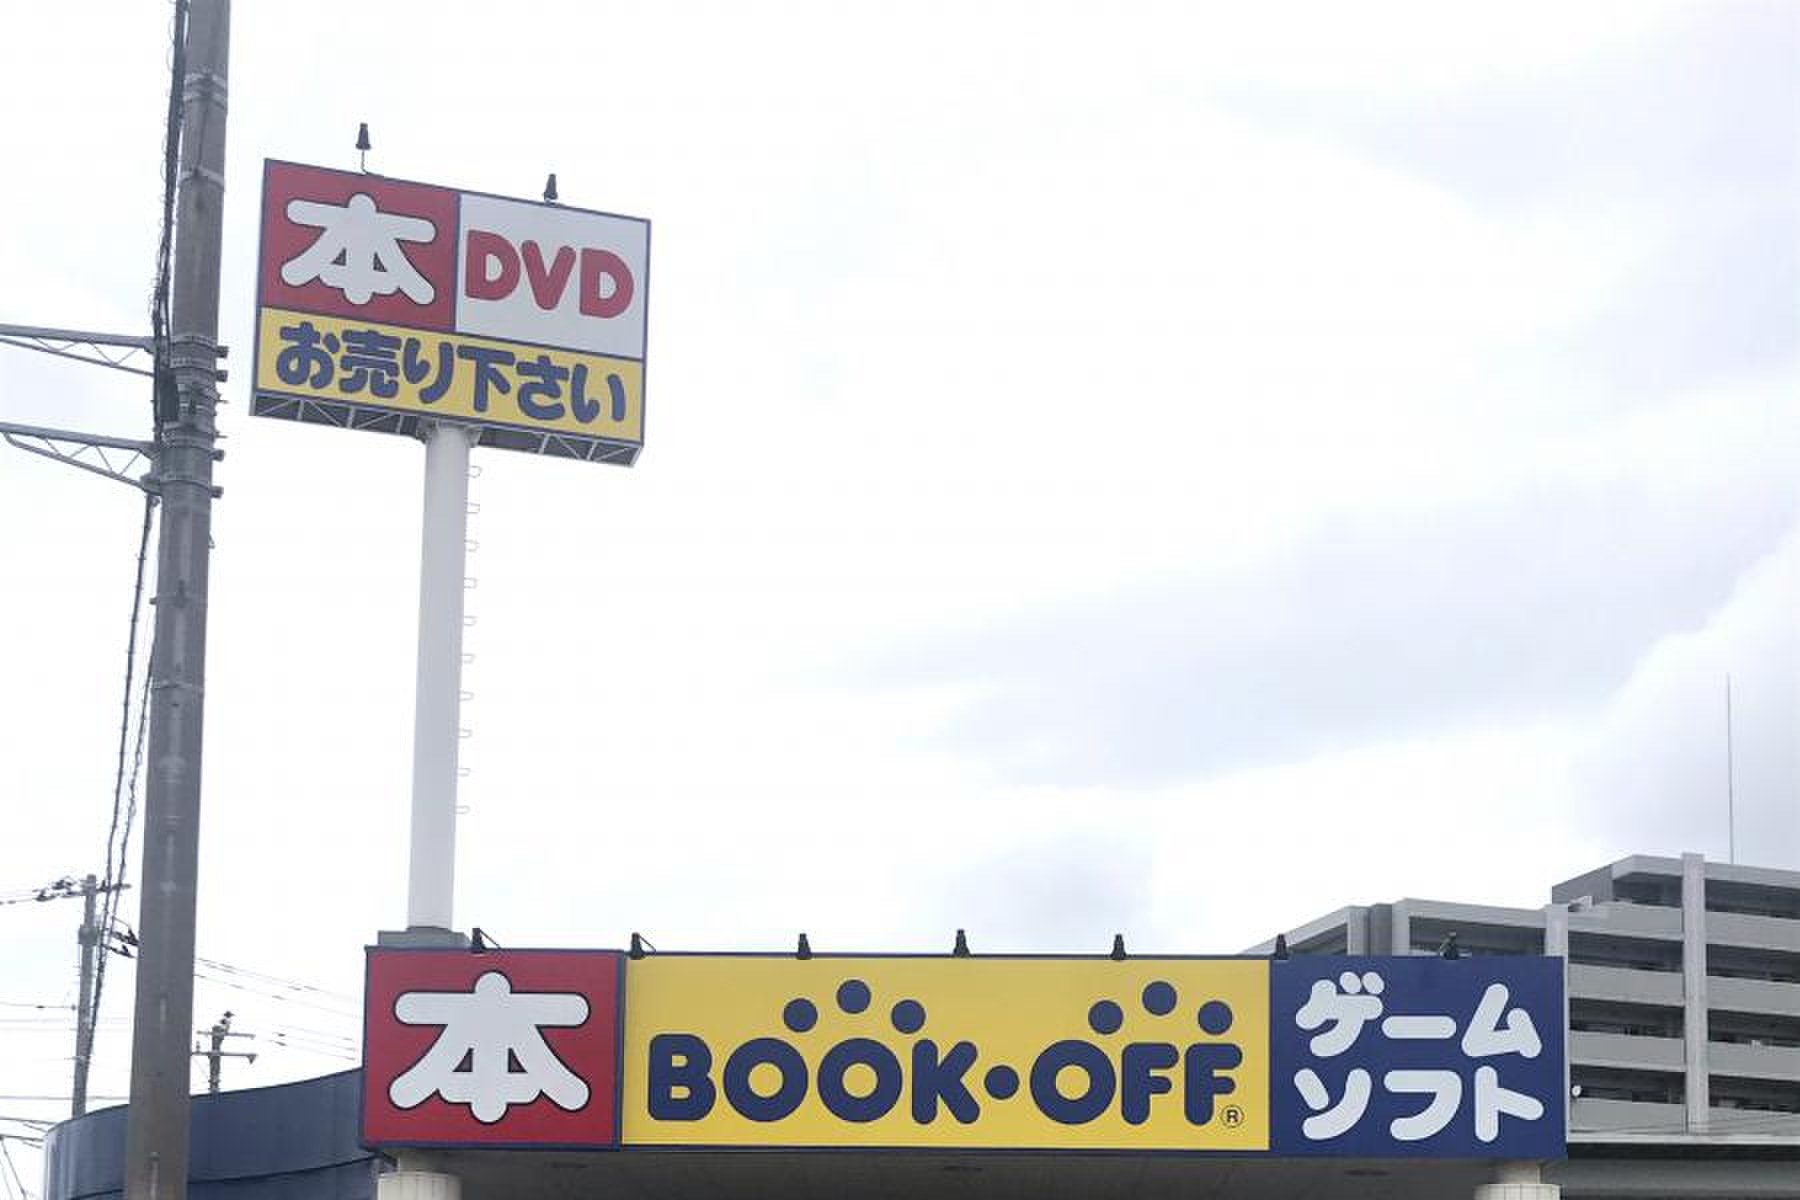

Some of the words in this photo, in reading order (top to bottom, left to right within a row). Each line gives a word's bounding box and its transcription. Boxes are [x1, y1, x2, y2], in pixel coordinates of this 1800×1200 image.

[281, 193, 436, 305] 本
[465, 229, 634, 319] DVD
[276, 321, 627, 424] お売り下さい
[388, 970, 591, 1125] 本
[1295, 971, 1542, 1058] ゲーム
[1293, 1066, 1545, 1143] ソフト
